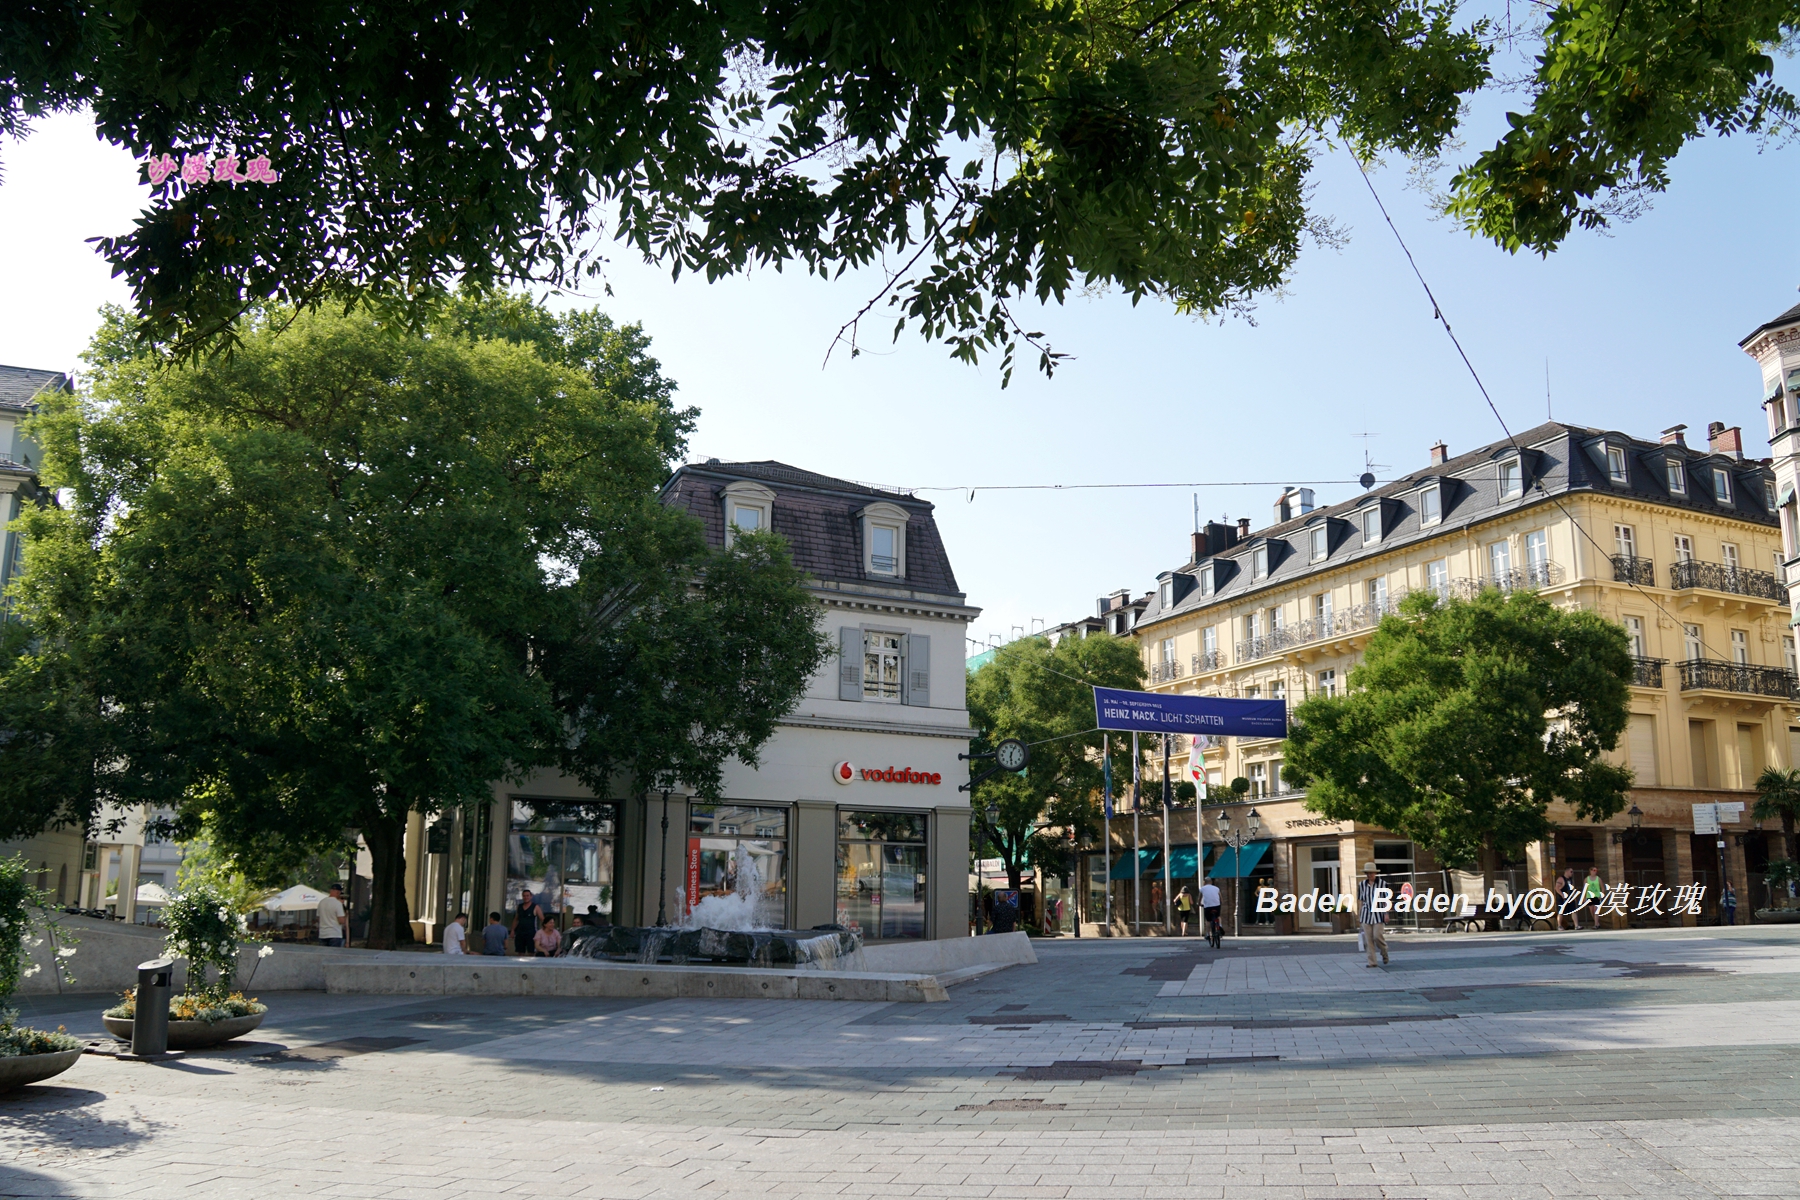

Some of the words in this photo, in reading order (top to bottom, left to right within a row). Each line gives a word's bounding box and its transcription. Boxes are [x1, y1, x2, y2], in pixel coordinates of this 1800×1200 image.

[1104, 708, 1130, 719] HEINZ
[1132, 710, 1158, 721] MACK.
[1160, 712, 1183, 723] LICHT
[1184, 714, 1224, 726] SCHATTEN
[861, 766, 942, 785] vodafone
[690, 849, 698, 869] Store
[689, 869, 697, 905] Business
